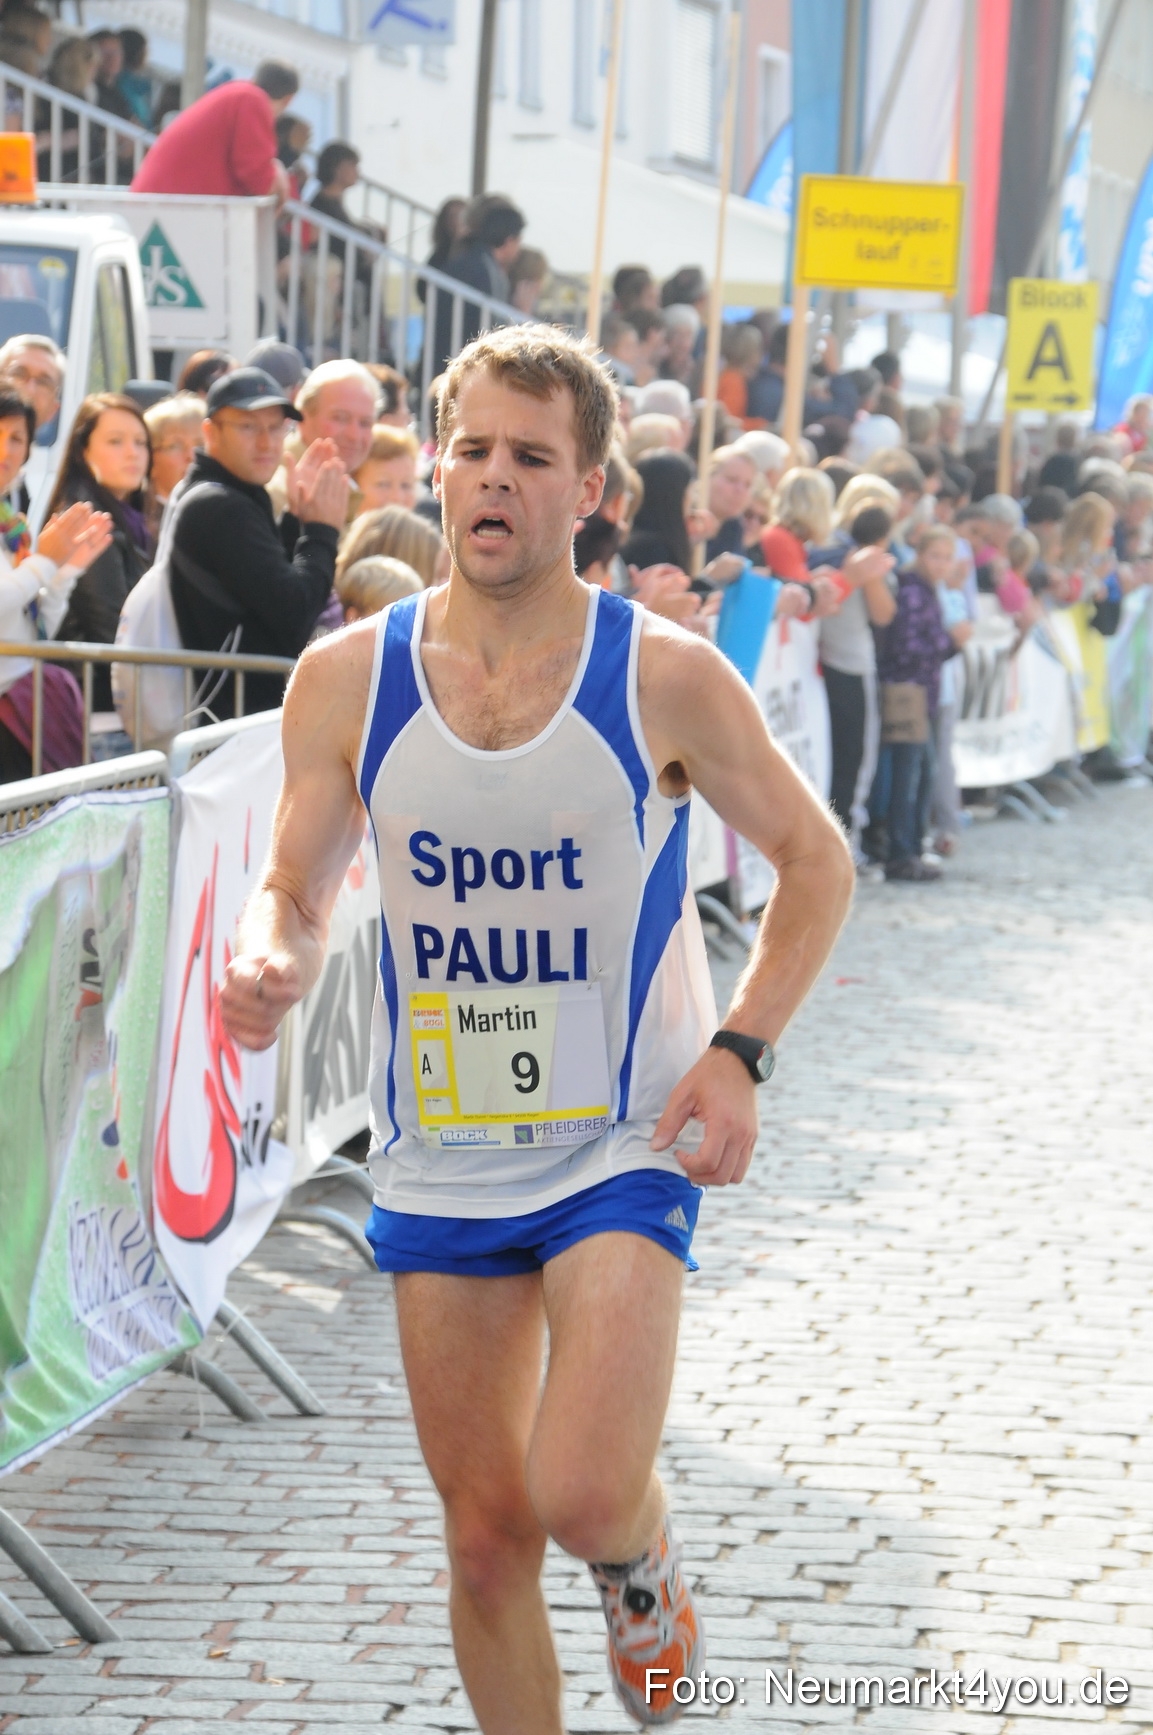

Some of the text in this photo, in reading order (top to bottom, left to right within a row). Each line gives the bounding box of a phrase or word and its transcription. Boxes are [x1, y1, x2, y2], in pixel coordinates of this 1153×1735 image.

[813, 206, 951, 237] Schnupper-
[856, 240, 902, 261] lauf
[1021, 282, 1086, 309] Block
[1026, 322, 1071, 382] A
[408, 830, 584, 903] Sport
[412, 923, 588, 984] PAULI
[457, 1003, 537, 1034] Martin
[421, 1053, 432, 1075] A
[511, 1051, 540, 1094] 9
[440, 1129, 488, 1141] BOCK
[535, 1116, 607, 1136] PFLEIDERER
